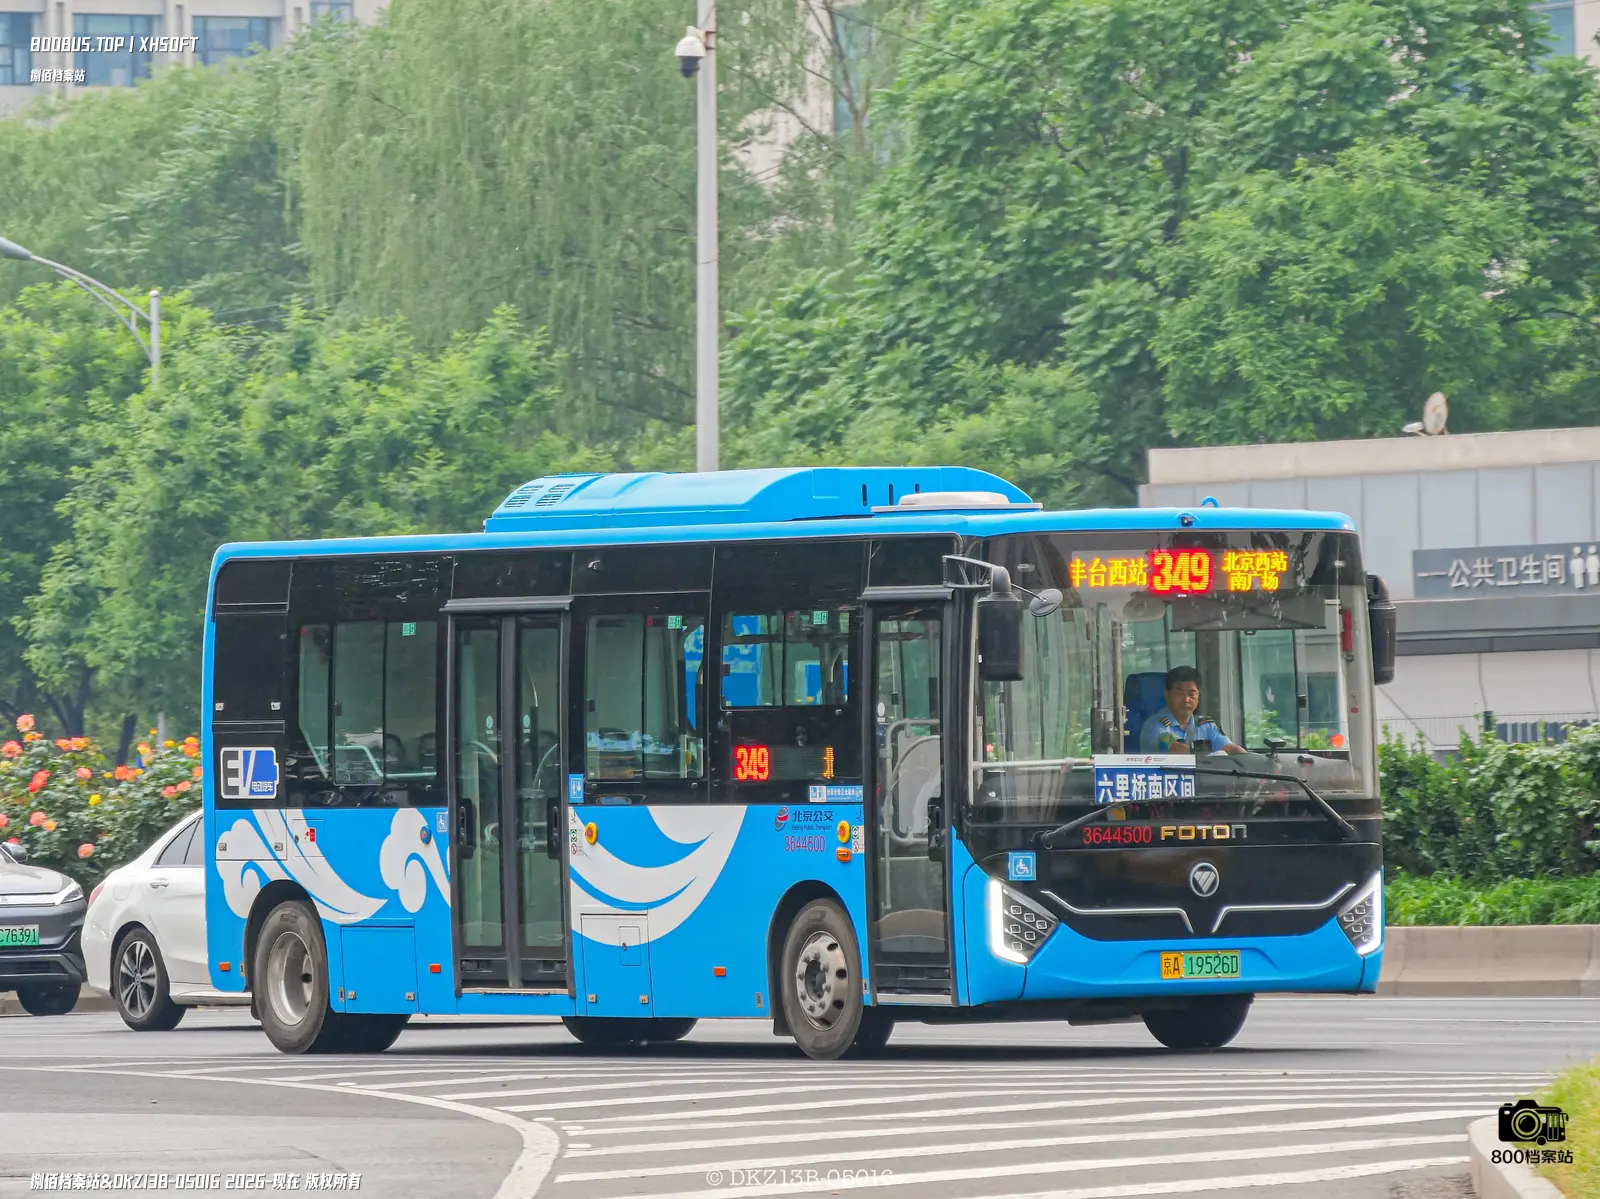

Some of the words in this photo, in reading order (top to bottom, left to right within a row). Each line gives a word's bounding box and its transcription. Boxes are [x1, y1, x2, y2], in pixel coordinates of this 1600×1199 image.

[1070, 557, 1147, 587] 丰台西站
[1153, 551, 1210, 591] 349
[1223, 551, 1288, 572] 北京西站
[1230, 571, 1280, 591] 南广场
[736, 747, 769, 780] 349
[1098, 773, 1196, 803] 六里桥南区间
[792, 810, 834, 822] 北京公交
[784, 835, 826, 852] 3644500
[1083, 826, 1152, 844] 3644500
